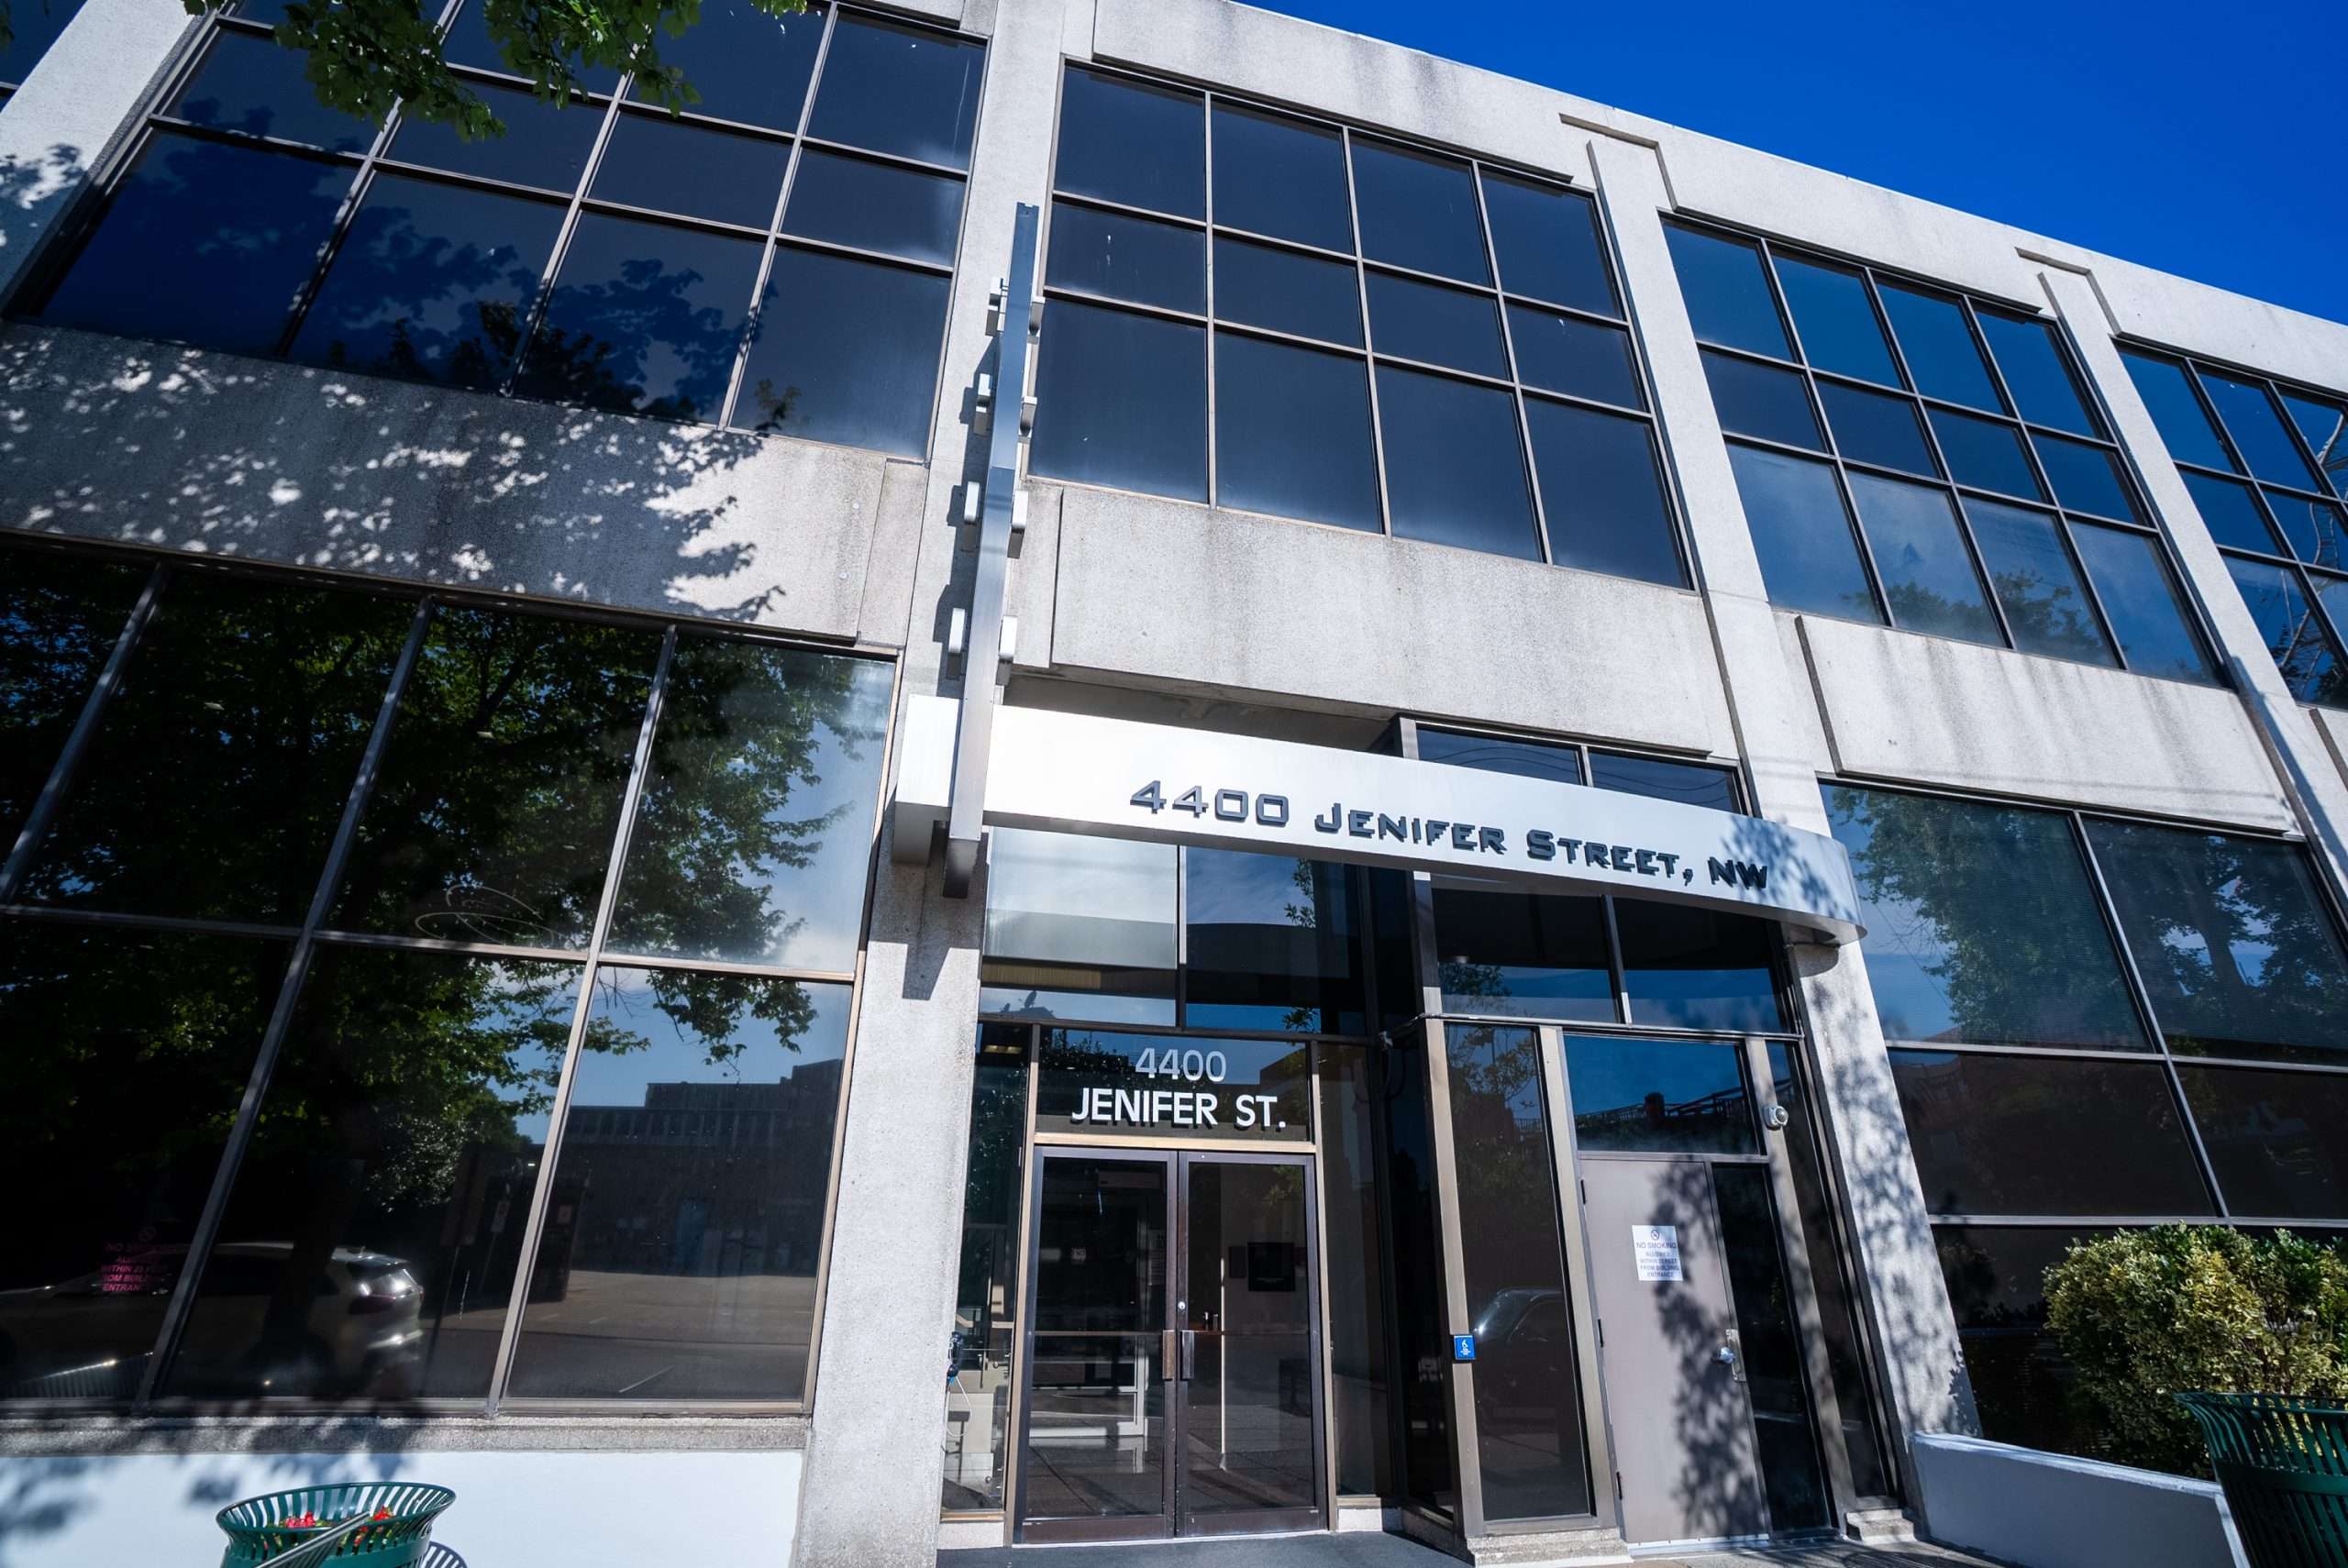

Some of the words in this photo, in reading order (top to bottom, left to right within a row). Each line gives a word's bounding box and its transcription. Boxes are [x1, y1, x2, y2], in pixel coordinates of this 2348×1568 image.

[1130, 780, 1290, 827] 4400
[1314, 803, 1508, 855] JENIFER
[1526, 829, 1694, 886] STREET,
[1707, 856, 1768, 889] NW
[1135, 1047, 1226, 1082] 4400
[1071, 1088, 1219, 1125] JENIFER
[1235, 1094, 1286, 1128] ST.
